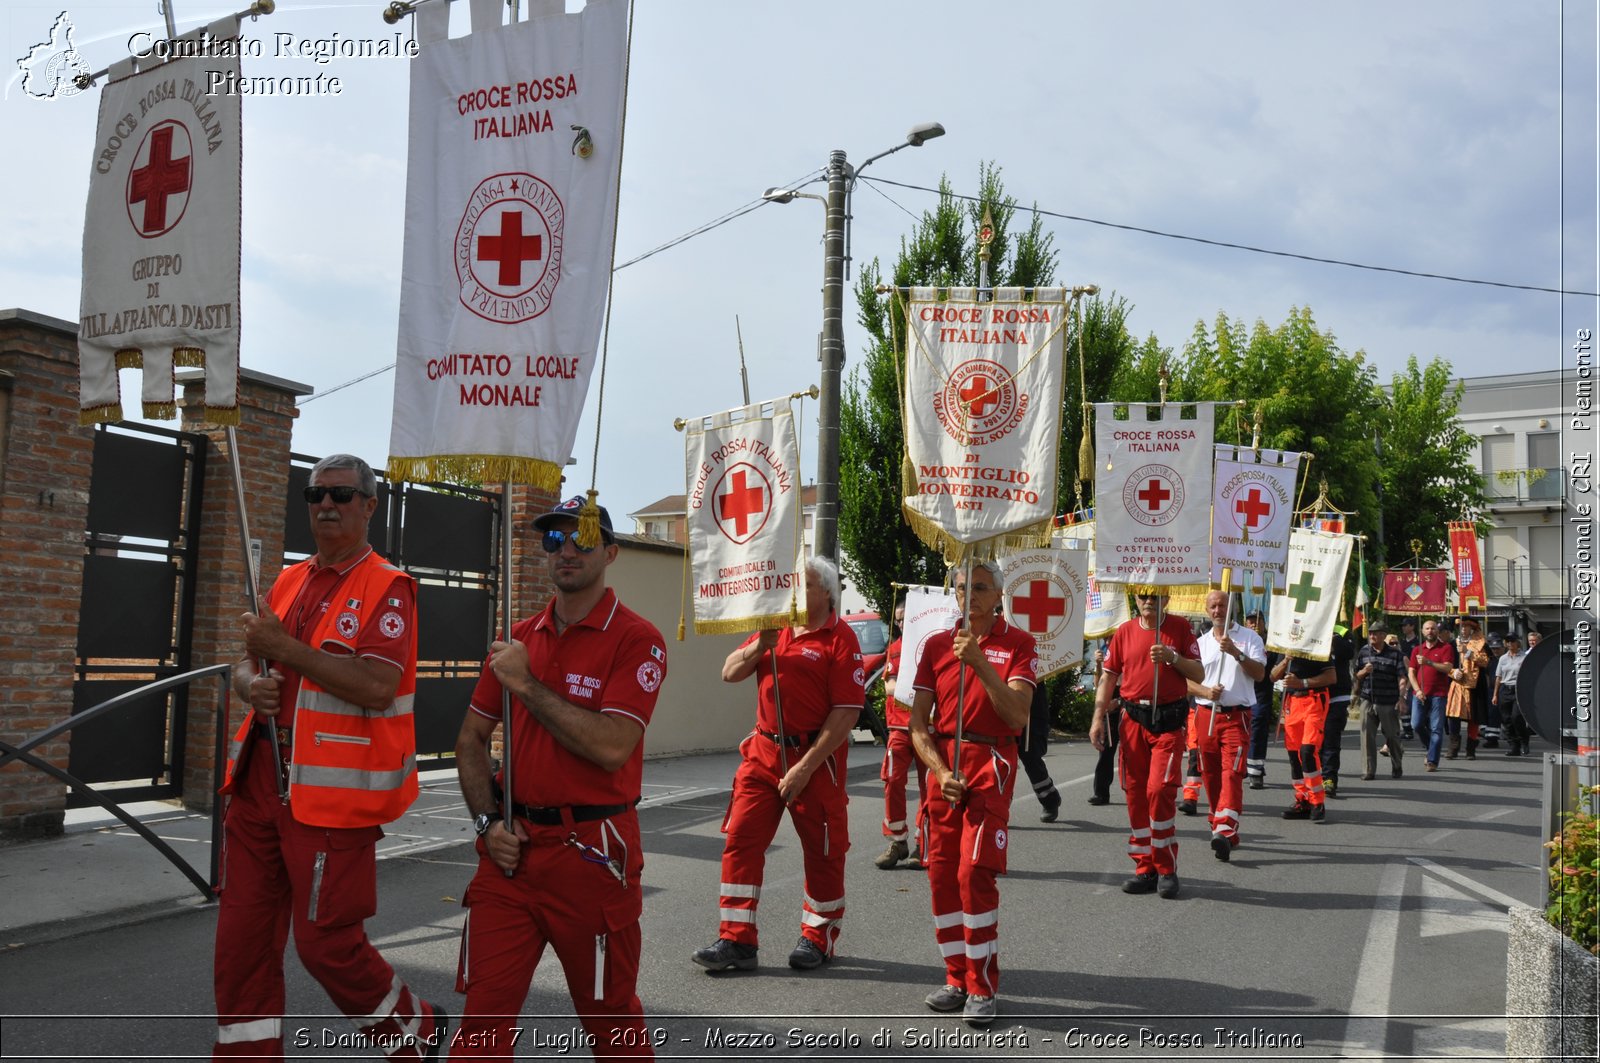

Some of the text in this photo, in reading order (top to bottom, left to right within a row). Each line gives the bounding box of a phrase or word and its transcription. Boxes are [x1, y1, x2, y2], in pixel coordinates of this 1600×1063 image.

[458, 74, 578, 116] CROCE ROSSA
[96, 78, 223, 175] CROCE ROSSA ITALIANA
[474, 110, 554, 140] ITALIANA
[476, 180, 505, 208] 1864
[522, 179, 562, 283] CONVENZIONE
[132, 253, 182, 281] GRUPPO
[146, 282, 160, 299] DI
[535, 283, 551, 306] DI
[470, 286, 537, 319] GINEVRA
[179, 303, 232, 330] D'ASTI
[919, 307, 1051, 324] CROCE ROSSA
[940, 329, 1028, 345] ITALIANA
[427, 355, 579, 381] COMITATO LOCALE
[956, 370, 966, 380] DI
[965, 364, 998, 376] GINEVRA
[460, 384, 541, 406] MONALE
[1002, 384, 1012, 415] AGOSTO
[983, 414, 1001, 428] 1864
[989, 393, 1029, 442] SOCCORSO
[1113, 430, 1196, 441] CROCE ROSSA
[1128, 442, 1180, 453] ITALIANA
[965, 454, 980, 464] DI
[692, 437, 792, 510] CROCE ROSSA ITALIANA
[920, 465, 1030, 485] MONTIGLIO
[1221, 470, 1289, 505] CROCE ROSSA ITALIANA
[955, 501, 983, 511] ASTI
[1116, 545, 1191, 553] CASTELNUOVO
[1256, 539, 1282, 548] LOCALE
[767, 560, 776, 571] DI
[1003, 560, 1020, 577] OCE
[1020, 554, 1053, 565] ROSSA
[1122, 556, 1184, 564] DON BOSCO
[1217, 557, 1258, 568] COCCONATO
[1157, 566, 1200, 574] MASSAIA
[764, 572, 800, 591] D'ASTI
[909, 607, 940, 624] VOLONTARI
[566, 673, 582, 685] CROCE
